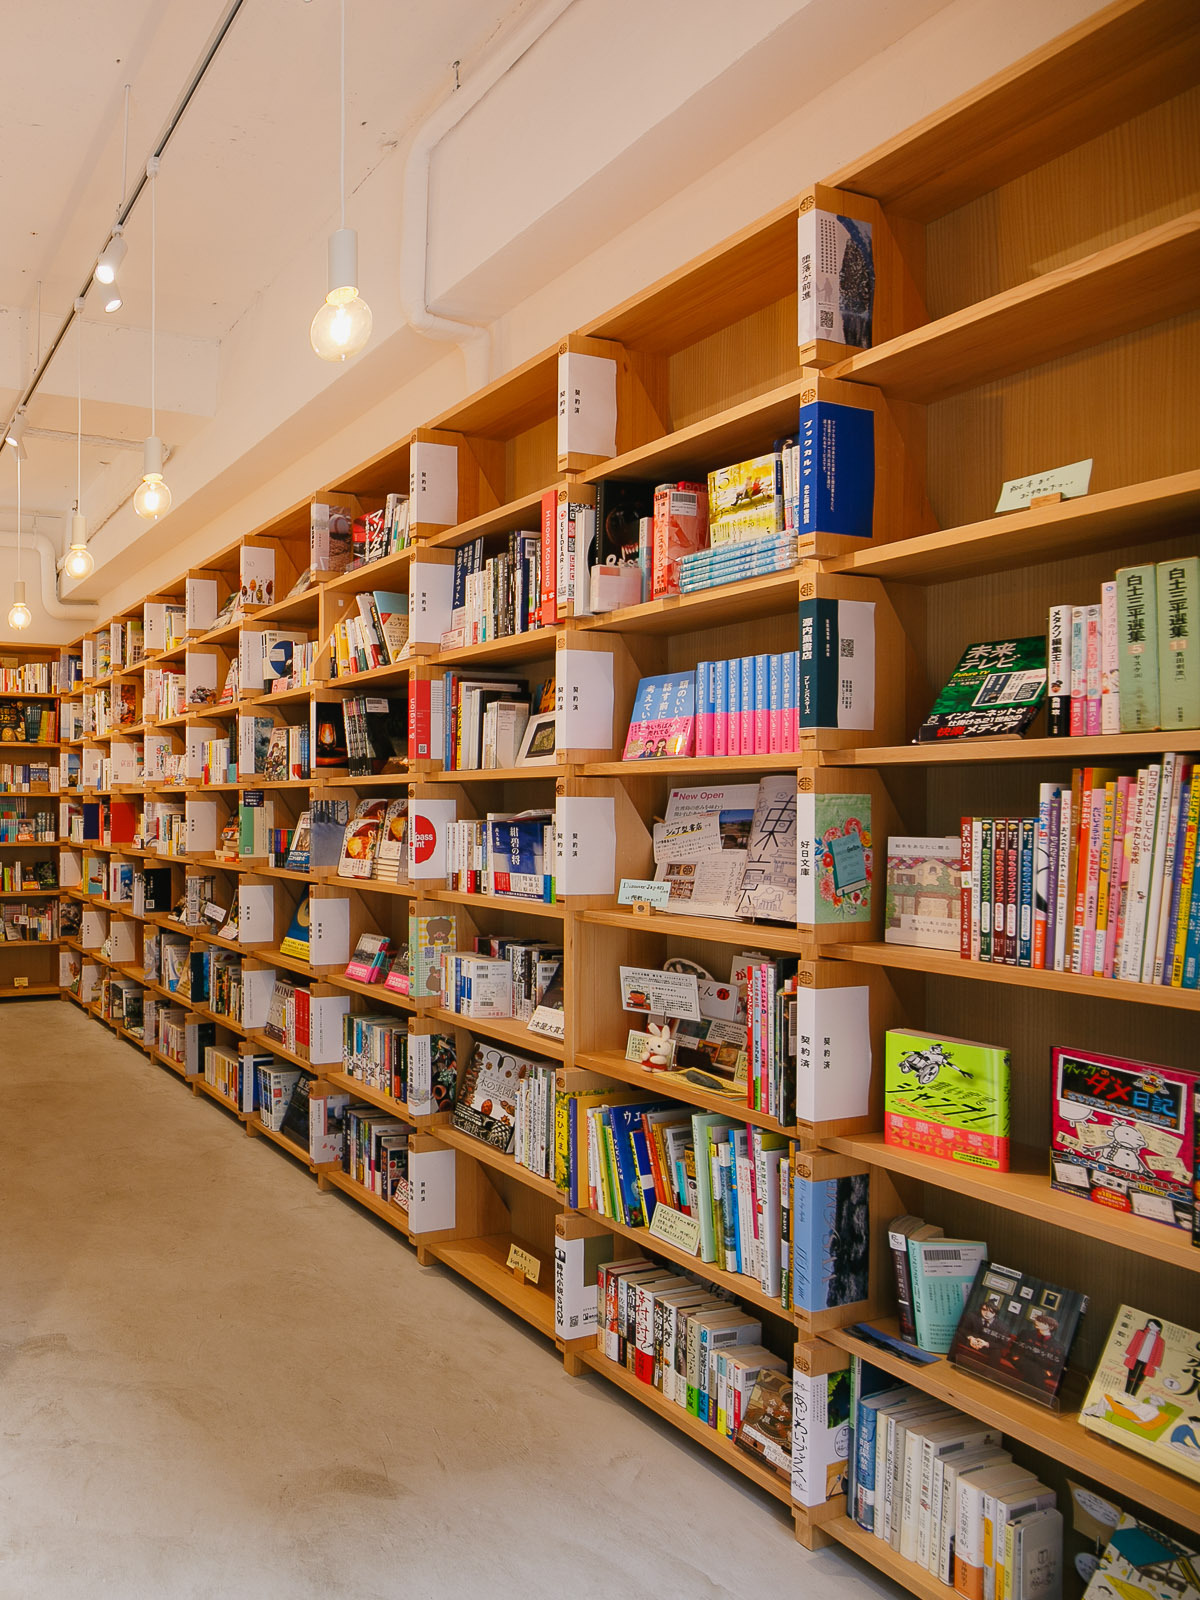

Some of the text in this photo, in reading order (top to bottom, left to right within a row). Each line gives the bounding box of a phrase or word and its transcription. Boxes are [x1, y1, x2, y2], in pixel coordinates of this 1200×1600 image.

[804, 420, 812, 476] ブックカルテ
[370, 510, 383, 556] マツダ
[1126, 574, 1146, 644] 白土三平選集
[1169, 568, 1188, 638] 白土三平選集
[960, 654, 1021, 672] テレビ
[966, 642, 1017, 658] 未来
[656, 682, 673, 719] 話す前に
[669, 679, 690, 734] 頭のいい人が
[944, 707, 1028, 720] インターネットが
[678, 792, 724, 800] New Open
[510, 826, 520, 865] 紺碧の将
[800, 840, 810, 876] 好日文庫
[800, 1035, 810, 1068] 契約済
[1064, 1063, 1110, 1077] グレッグの
[1084, 1073, 1176, 1118] ダメ日記
[556, 1109, 564, 1150] おひたま
